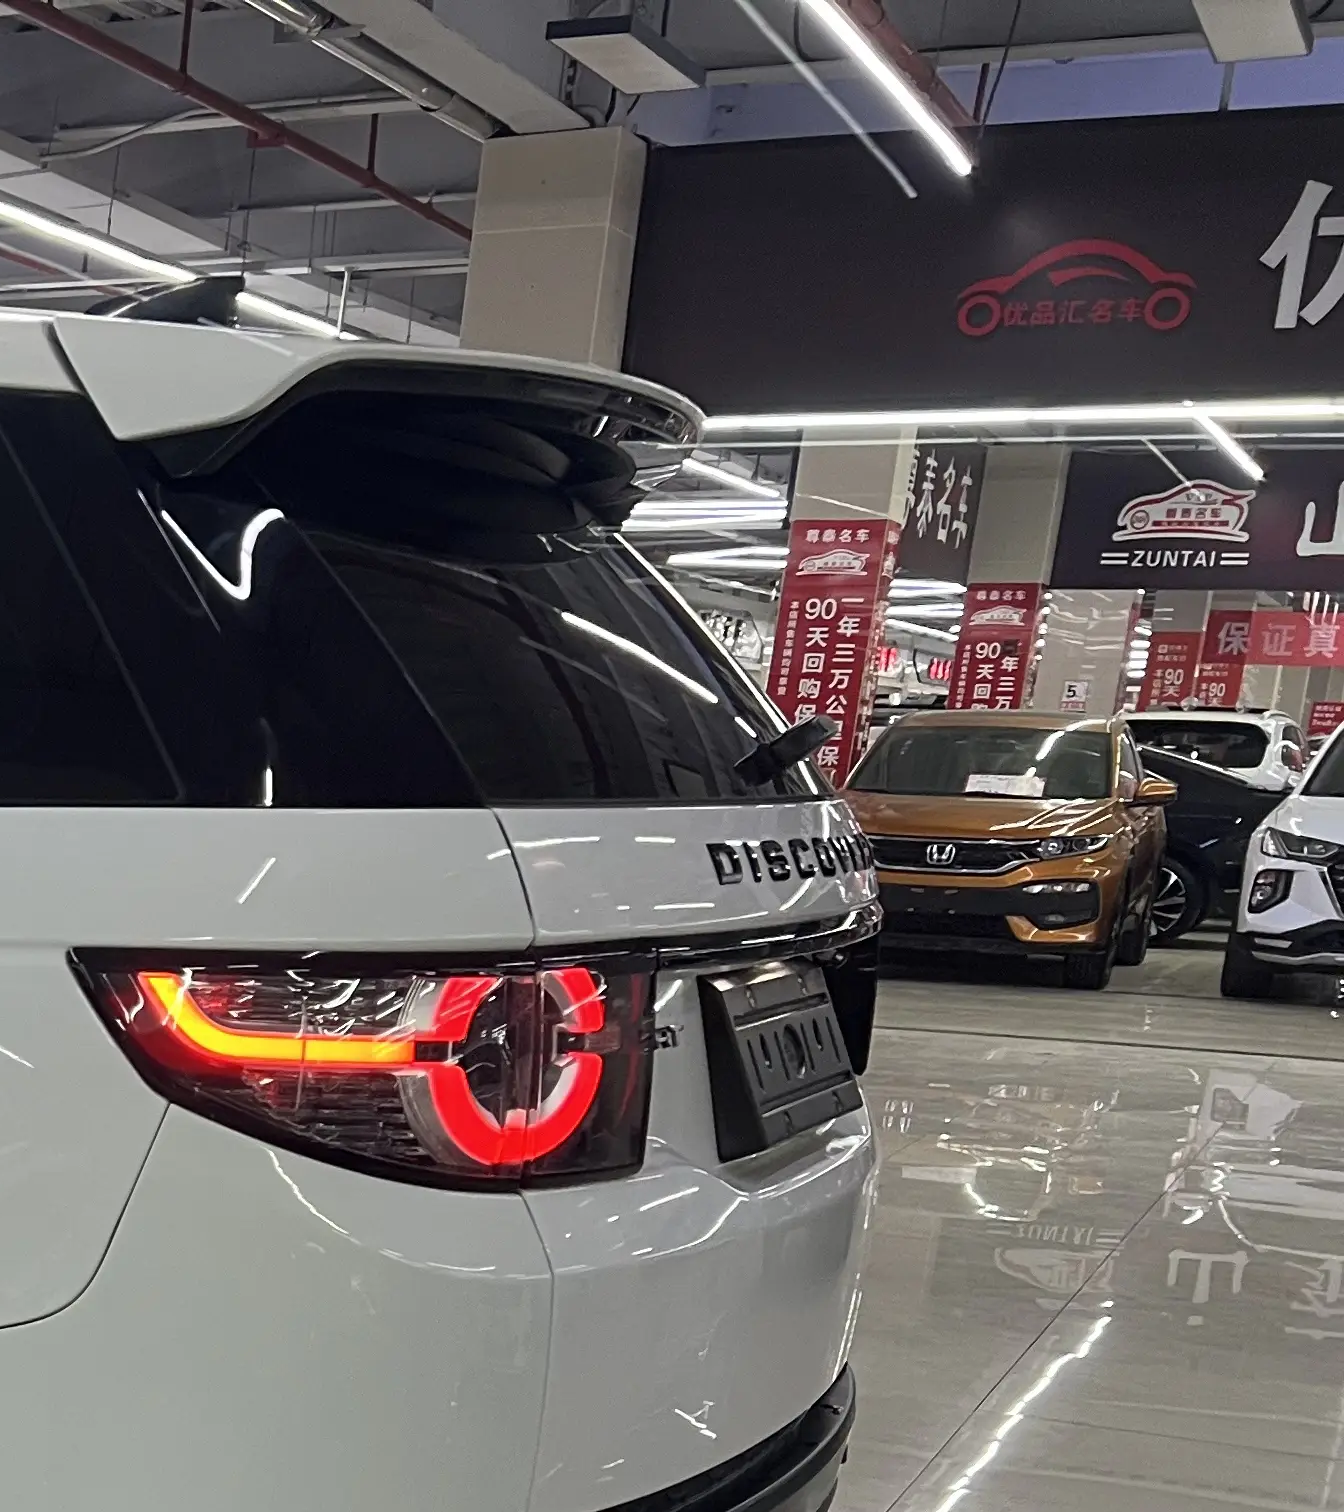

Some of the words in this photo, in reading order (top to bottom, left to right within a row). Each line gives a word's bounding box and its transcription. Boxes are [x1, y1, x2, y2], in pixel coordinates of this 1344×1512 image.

[1003, 298, 1145, 326] 优品汇名车
[1131, 550, 1217, 567] ZUNTAI
[994, 643, 1022, 710] 年三万
[1066, 682, 1077, 699] 5
[1162, 668, 1185, 706] 90天
